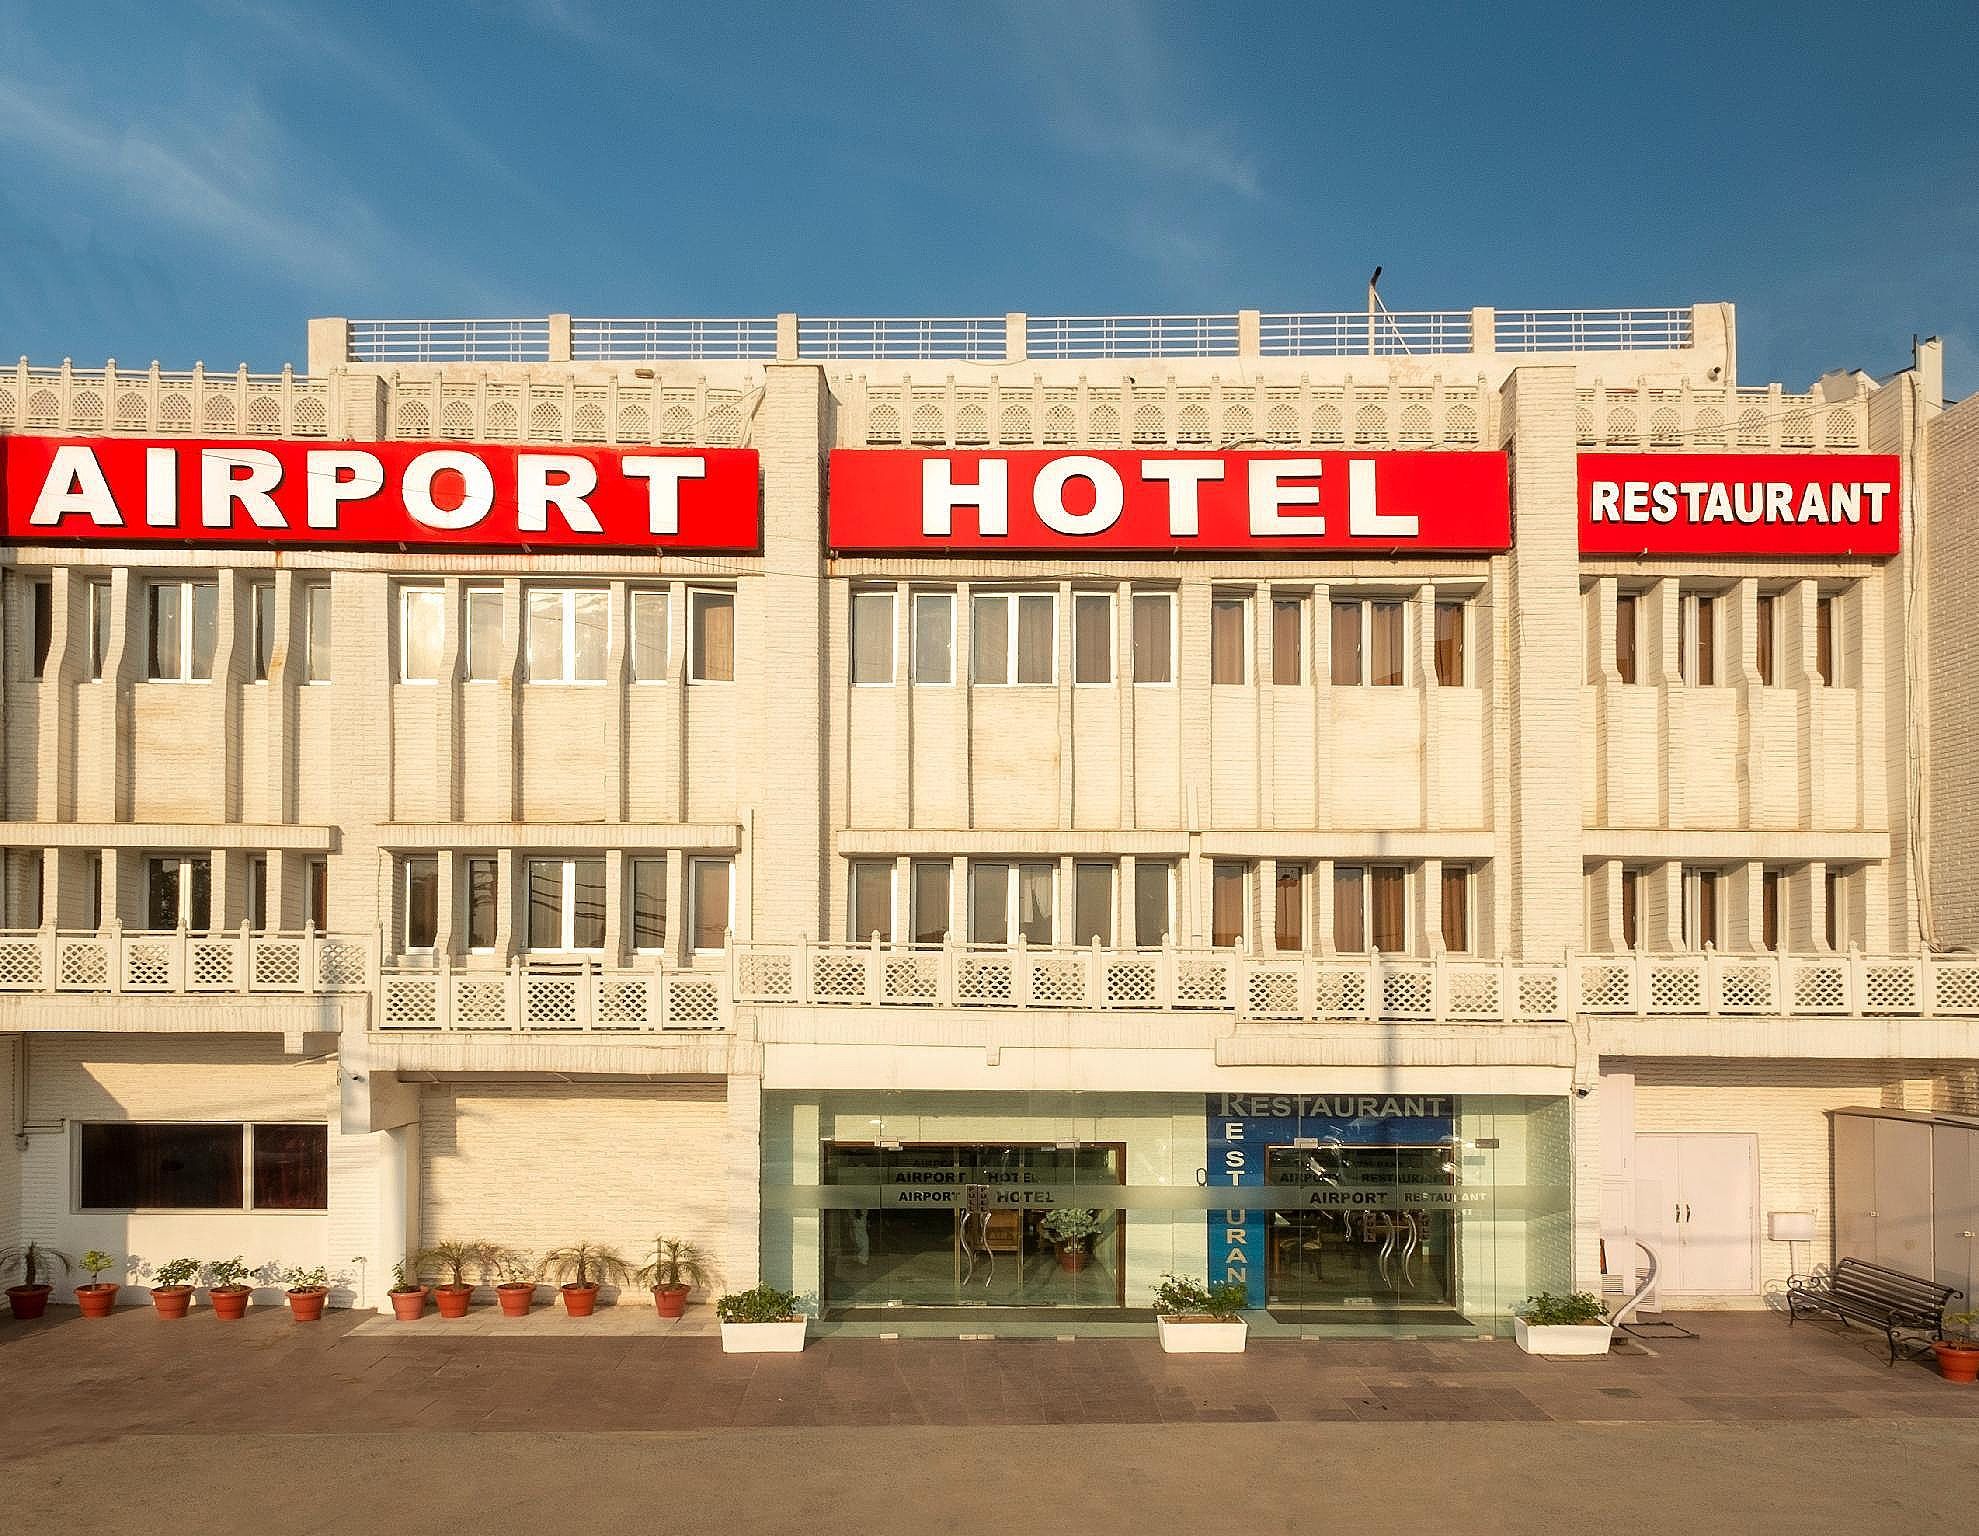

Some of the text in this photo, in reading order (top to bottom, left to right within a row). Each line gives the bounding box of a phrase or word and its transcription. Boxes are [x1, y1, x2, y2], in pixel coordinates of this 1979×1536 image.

[30, 445, 707, 535] AIRPORT
[922, 455, 1420, 536] HOTEL
[1591, 481, 1891, 524] RESTAURANT
[1217, 1093, 1447, 1118] RESTAURANT
[895, 1172, 966, 1183] AIRPORT
[898, 1191, 961, 1202] AIRPORT
[997, 1191, 1055, 1203] HOTEL
[1309, 1192, 1388, 1204] AIRPORT
